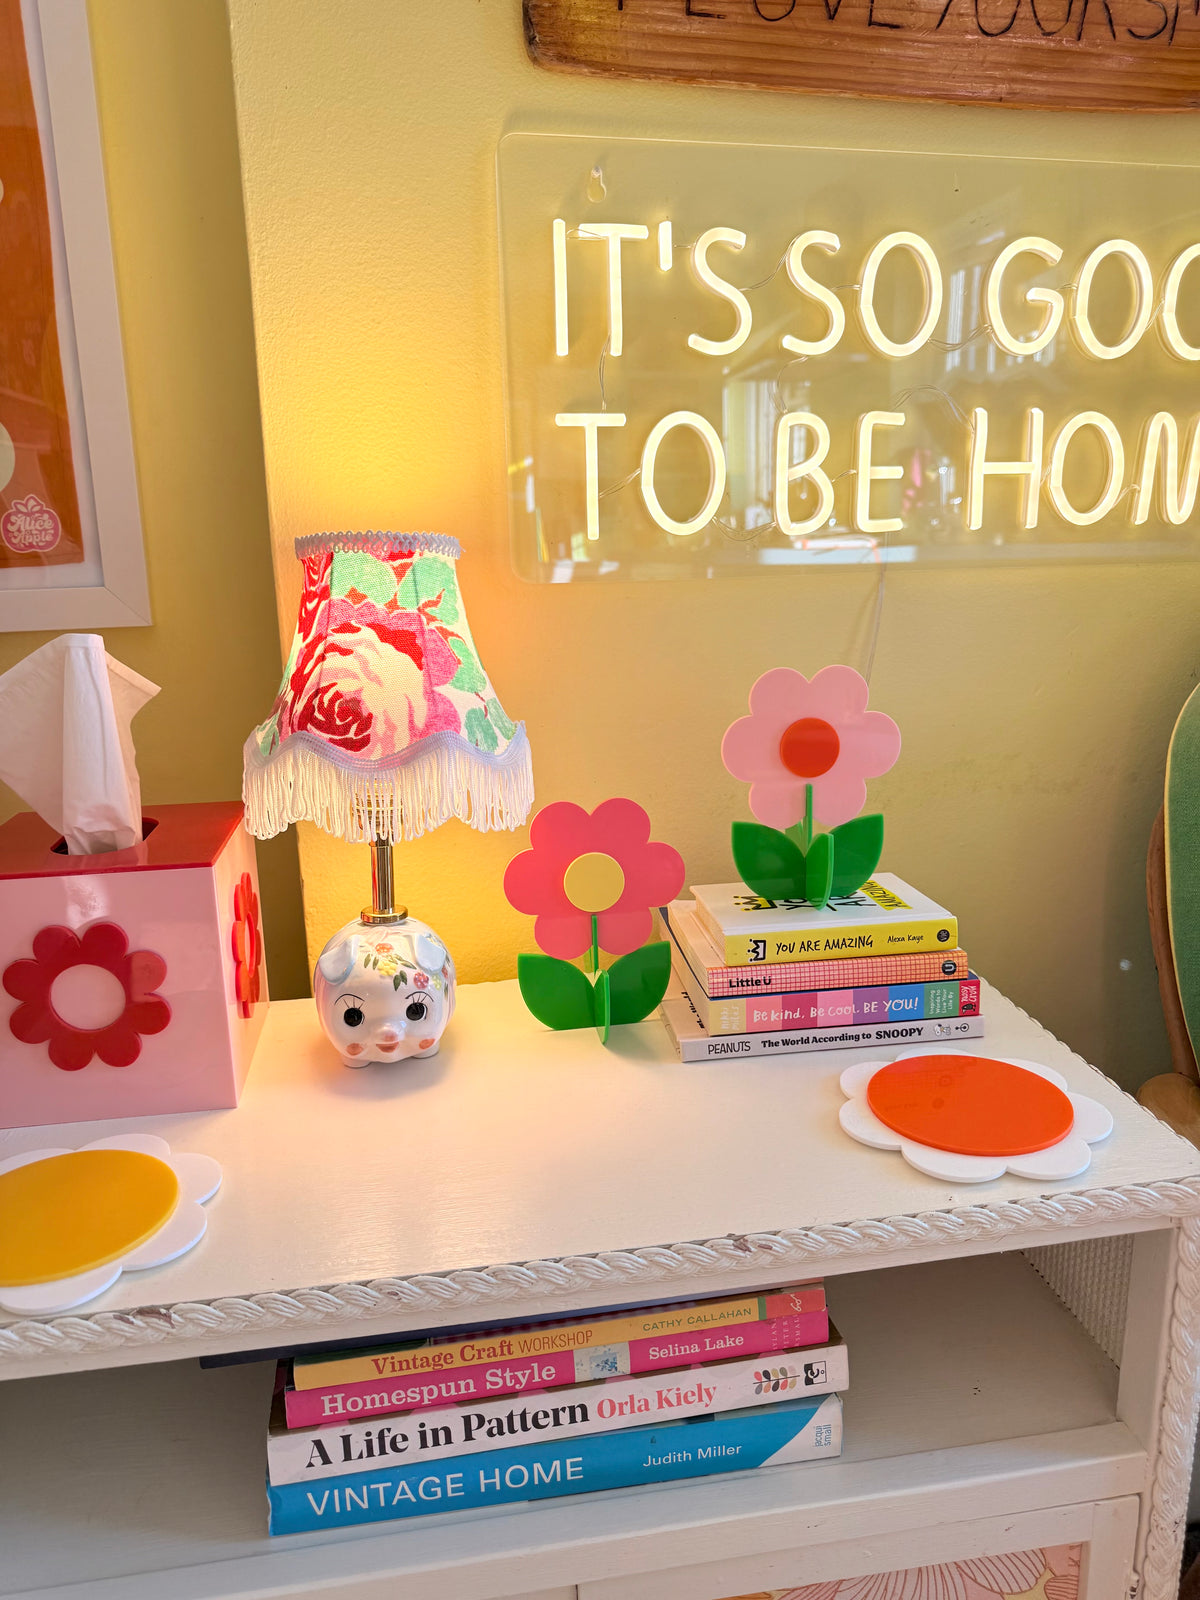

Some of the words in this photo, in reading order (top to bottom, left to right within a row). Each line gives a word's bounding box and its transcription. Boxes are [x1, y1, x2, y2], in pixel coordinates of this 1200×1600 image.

[553, 218, 752, 356] IT'S
[782, 230, 943, 357] SO
[555, 411, 726, 540] TO
[773, 410, 906, 535] BE
[7, 513, 54, 532] Alice
[9, 530, 54, 547] Apple
[776, 941, 797, 955] YOU
[799, 939, 821, 953] ARE
[823, 934, 874, 952] AMAZING
[887, 935, 906, 944] Alexa
[907, 934, 924, 944] Kaye
[729, 977, 761, 989] Little
[753, 1009, 768, 1023] Be
[810, 1006, 825, 1018] Be
[863, 1001, 878, 1014] BE
[883, 997, 919, 1012] YOU!
[708, 1041, 751, 1055] PEANUTS
[761, 1039, 780, 1048] The
[781, 1037, 810, 1047] World
[811, 1032, 860, 1044] According
[862, 1031, 872, 1040] to
[875, 1027, 924, 1040] SNOOPY
[643, 1318, 683, 1331] CATHY
[687, 1308, 752, 1325] CALLAHAN
[371, 1352, 454, 1375] Vintage
[459, 1339, 514, 1362] Craft
[518, 1330, 593, 1354] WORKSHOP
[649, 1344, 700, 1360] Selina
[704, 1335, 744, 1351] Lake
[321, 1378, 477, 1416] Homespun
[485, 1362, 556, 1390] Style
[597, 1395, 650, 1419] Orla
[656, 1382, 717, 1410] Kiely
[305, 1439, 333, 1468] A
[339, 1427, 409, 1464] Life
[418, 1422, 453, 1449] in
[460, 1402, 590, 1442] Pattern
[643, 1451, 692, 1467] Judith
[697, 1444, 743, 1460] Miller
[306, 1473, 465, 1516] VINTAGE
[479, 1457, 584, 1493] HOME
